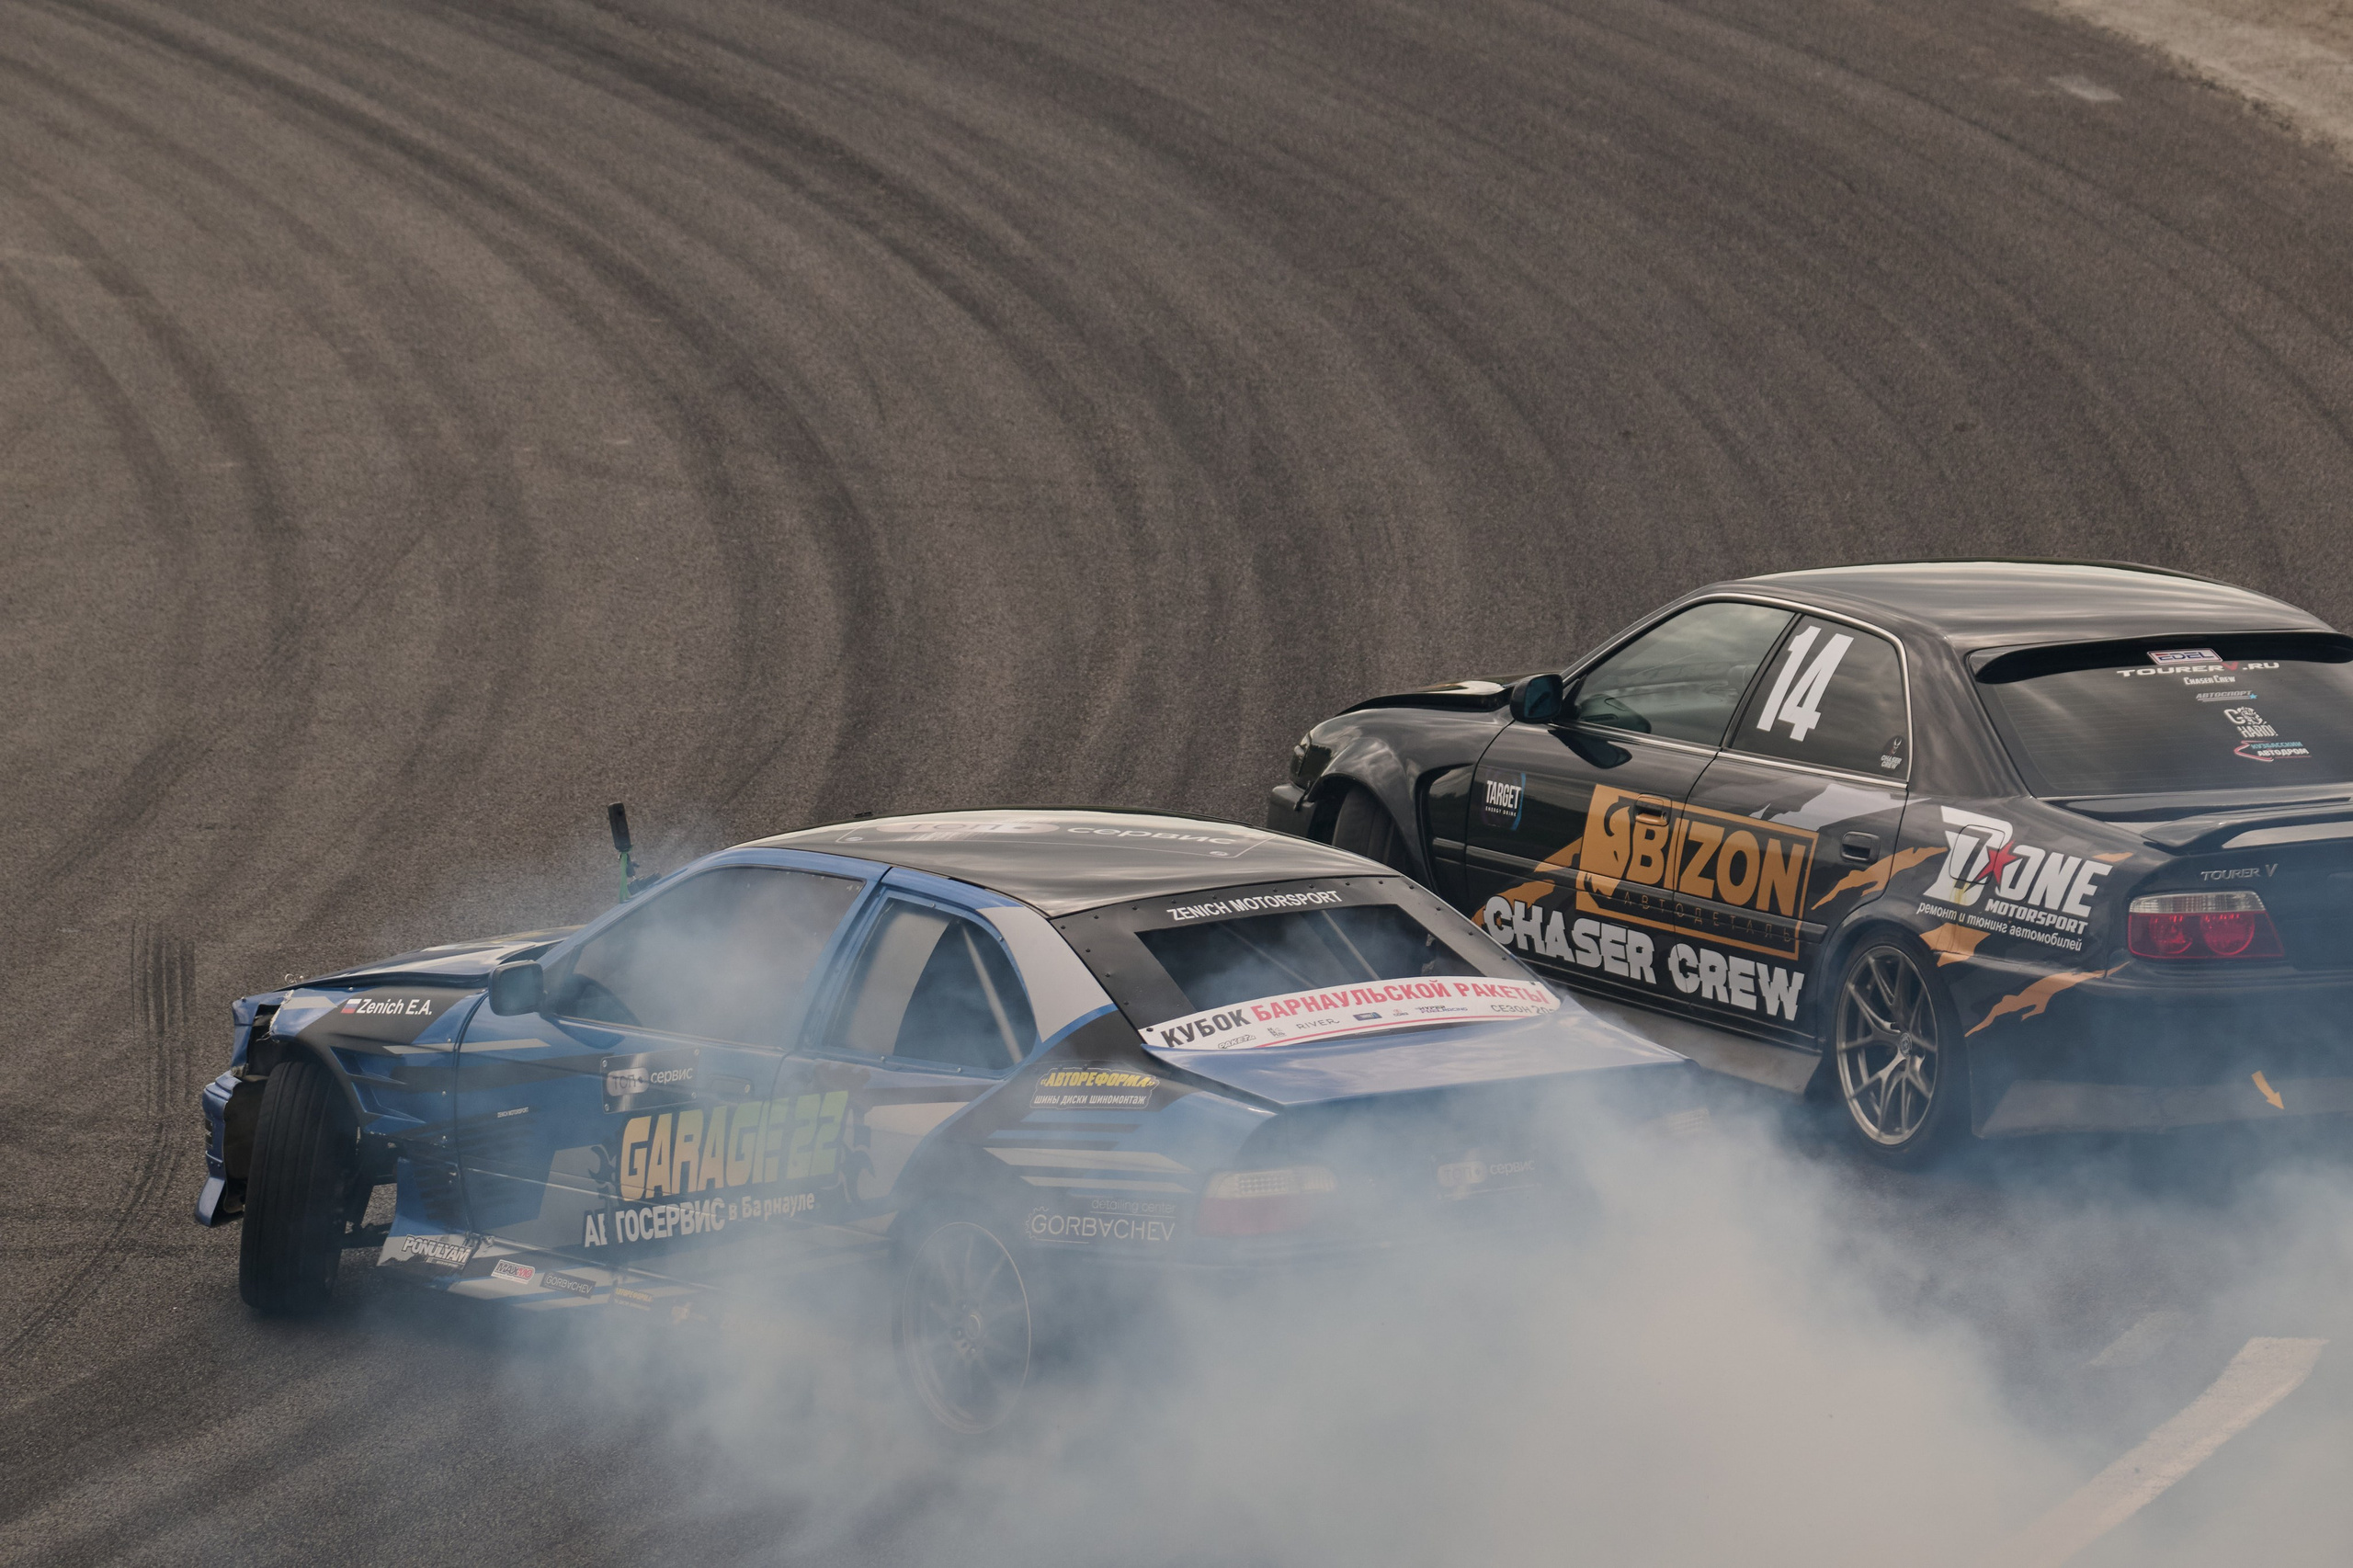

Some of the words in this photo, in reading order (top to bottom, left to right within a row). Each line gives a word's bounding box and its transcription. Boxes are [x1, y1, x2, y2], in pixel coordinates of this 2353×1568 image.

[1756, 626, 1854, 742] 14
[2196, 690, 2253, 699] АВТОСПОРТ
[2236, 724, 2279, 739] HARD!
[2257, 747, 2310, 757] АВТОДРОМ
[1486, 780, 1522, 810] TARGET
[1066, 826, 1236, 845] сервис
[1626, 817, 1806, 917] BIZON
[2200, 868, 2261, 881] TOURER
[2265, 863, 2279, 877] V
[1167, 900, 1231, 921] ZENICH
[1233, 890, 1343, 914] MOTORSPORT
[1624, 891, 1791, 942] АВТОДЕТАЛЬ
[1985, 899, 2088, 935] MOTORSPORT
[1916, 902, 1958, 921] ремонт
[1959, 912, 1965, 922] и
[1967, 915, 2008, 933] тюнинг
[2009, 924, 2083, 951] автомобилей
[1483, 896, 1656, 984] CHASER
[1668, 943, 1805, 1021] CREW
[357, 998, 404, 1015] Zenich
[405, 998, 433, 1016] E.A.
[1160, 1009, 1251, 1048] КУБОК
[1251, 979, 1450, 1022] БАРНАУЛЬСКОЙ
[1456, 982, 1552, 1006] РАКЕТЫ
[1490, 1004, 1532, 1014] СЕЗОН
[1296, 1018, 1340, 1029] RIVER
[612, 1074, 636, 1090] ТОП
[650, 1067, 694, 1085] сервис
[620, 1097, 790, 1201] GARAGE
[787, 1090, 848, 1179] 22
[1489, 1160, 1536, 1176] сервис
[729, 1203, 737, 1221] в
[742, 1193, 814, 1221] Барнауле
[1091, 1199, 1139, 1213] detailing
[1141, 1202, 1176, 1214] center
[403, 1234, 472, 1263] PONULYAM
